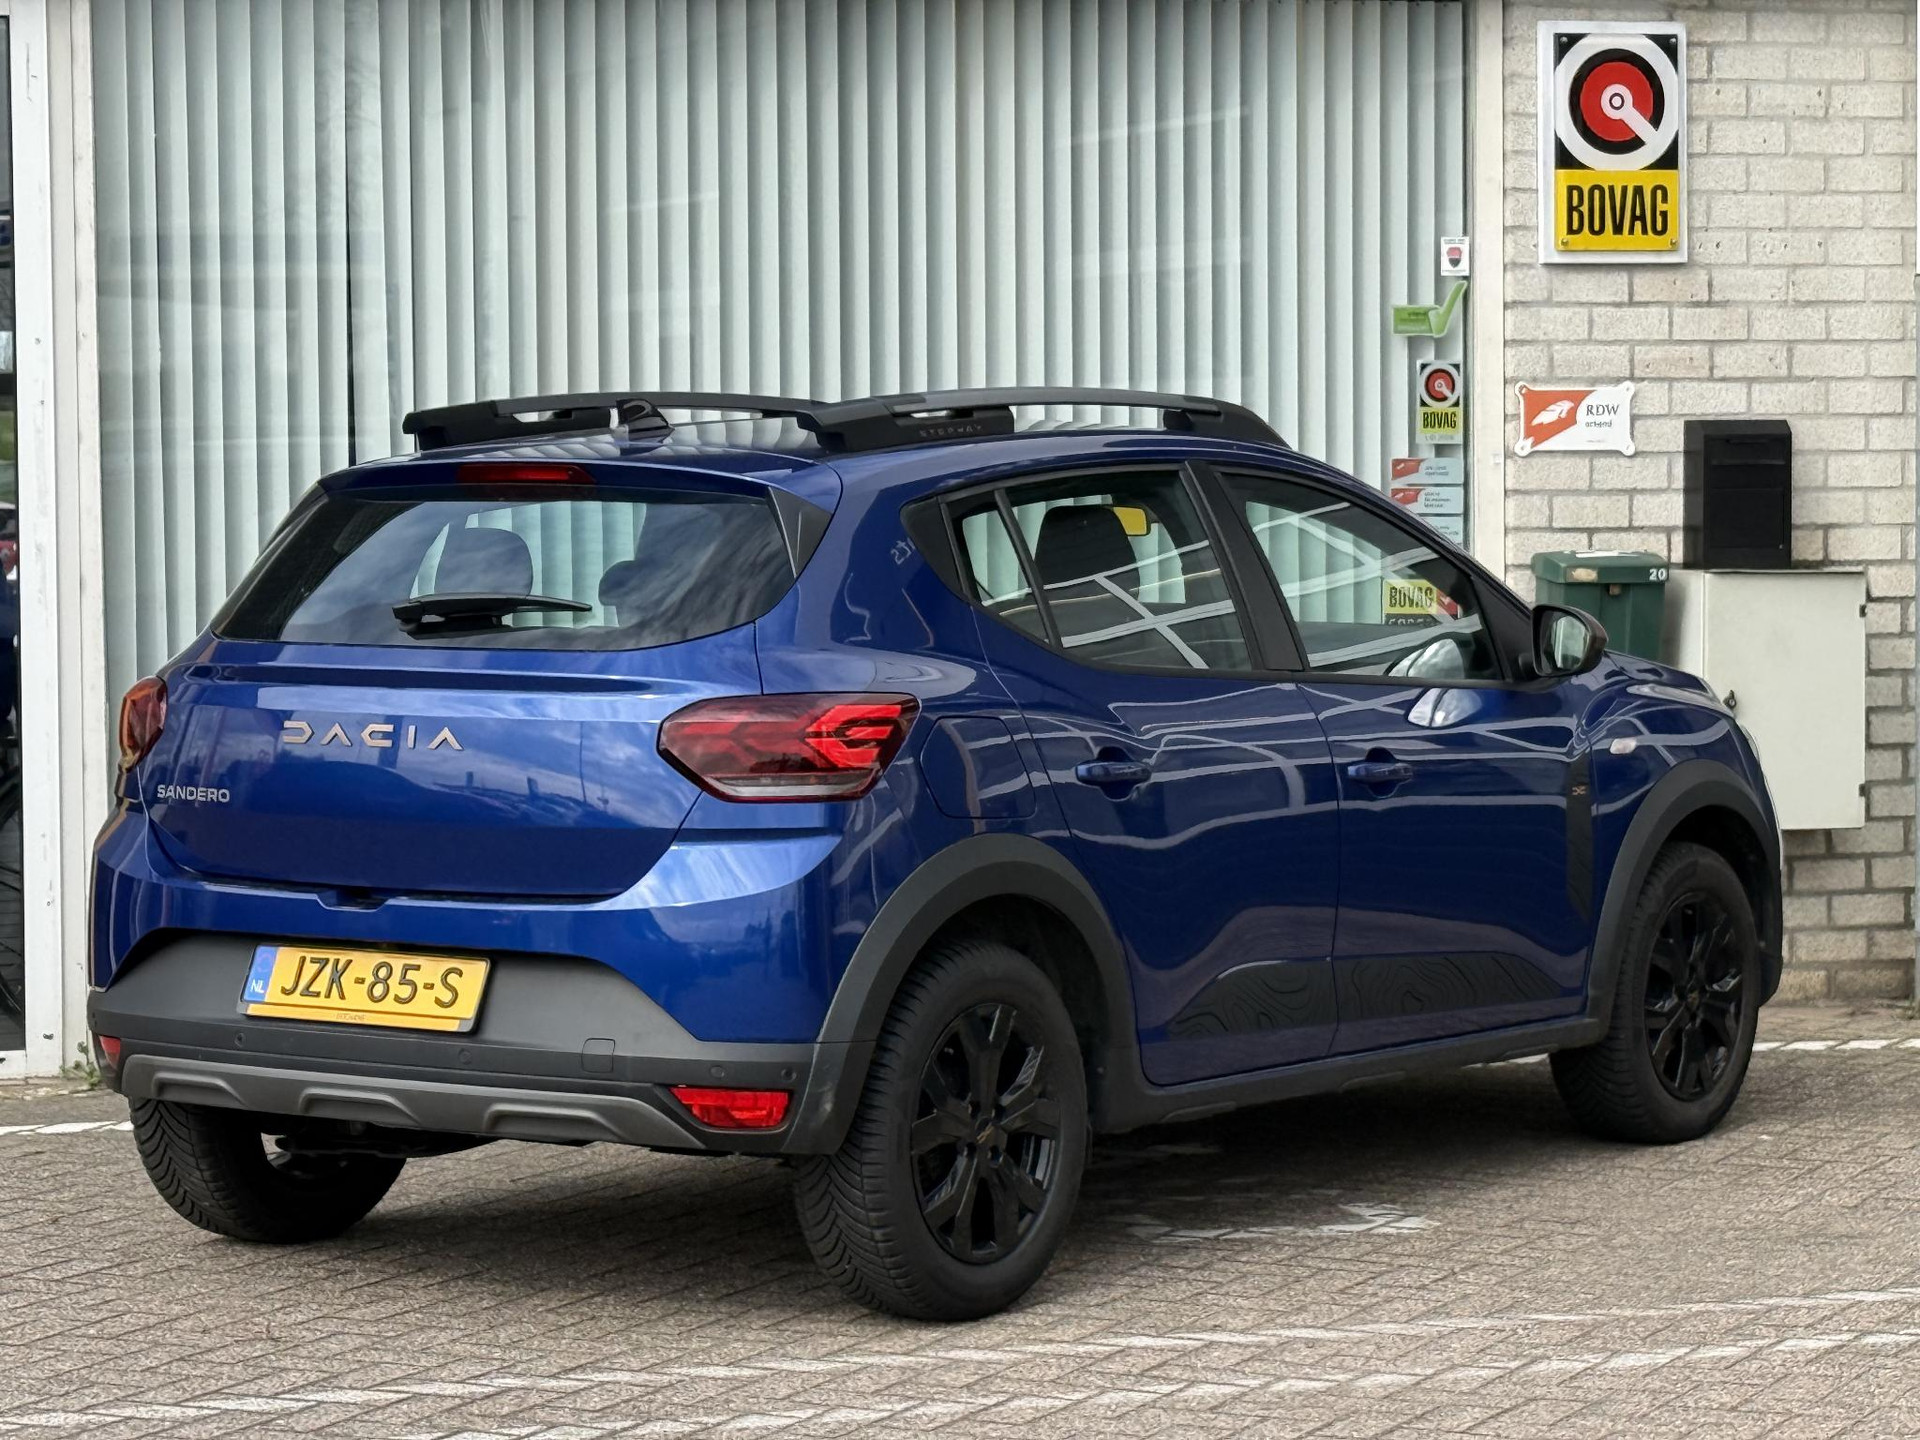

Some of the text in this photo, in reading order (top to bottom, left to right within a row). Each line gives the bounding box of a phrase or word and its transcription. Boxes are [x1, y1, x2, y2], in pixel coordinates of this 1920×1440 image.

[1565, 183, 1670, 237] BOVAG
[1422, 411, 1457, 429] BOVAG
[1586, 404, 1620, 416] RDW
[1649, 568, 1667, 581] 20
[1389, 586, 1433, 608] BOVAG
[282, 719, 464, 752] DACIA
[156, 784, 231, 804] SANDERO
[249, 978, 265, 995] NL
[280, 955, 463, 1008] JZK-85-S
